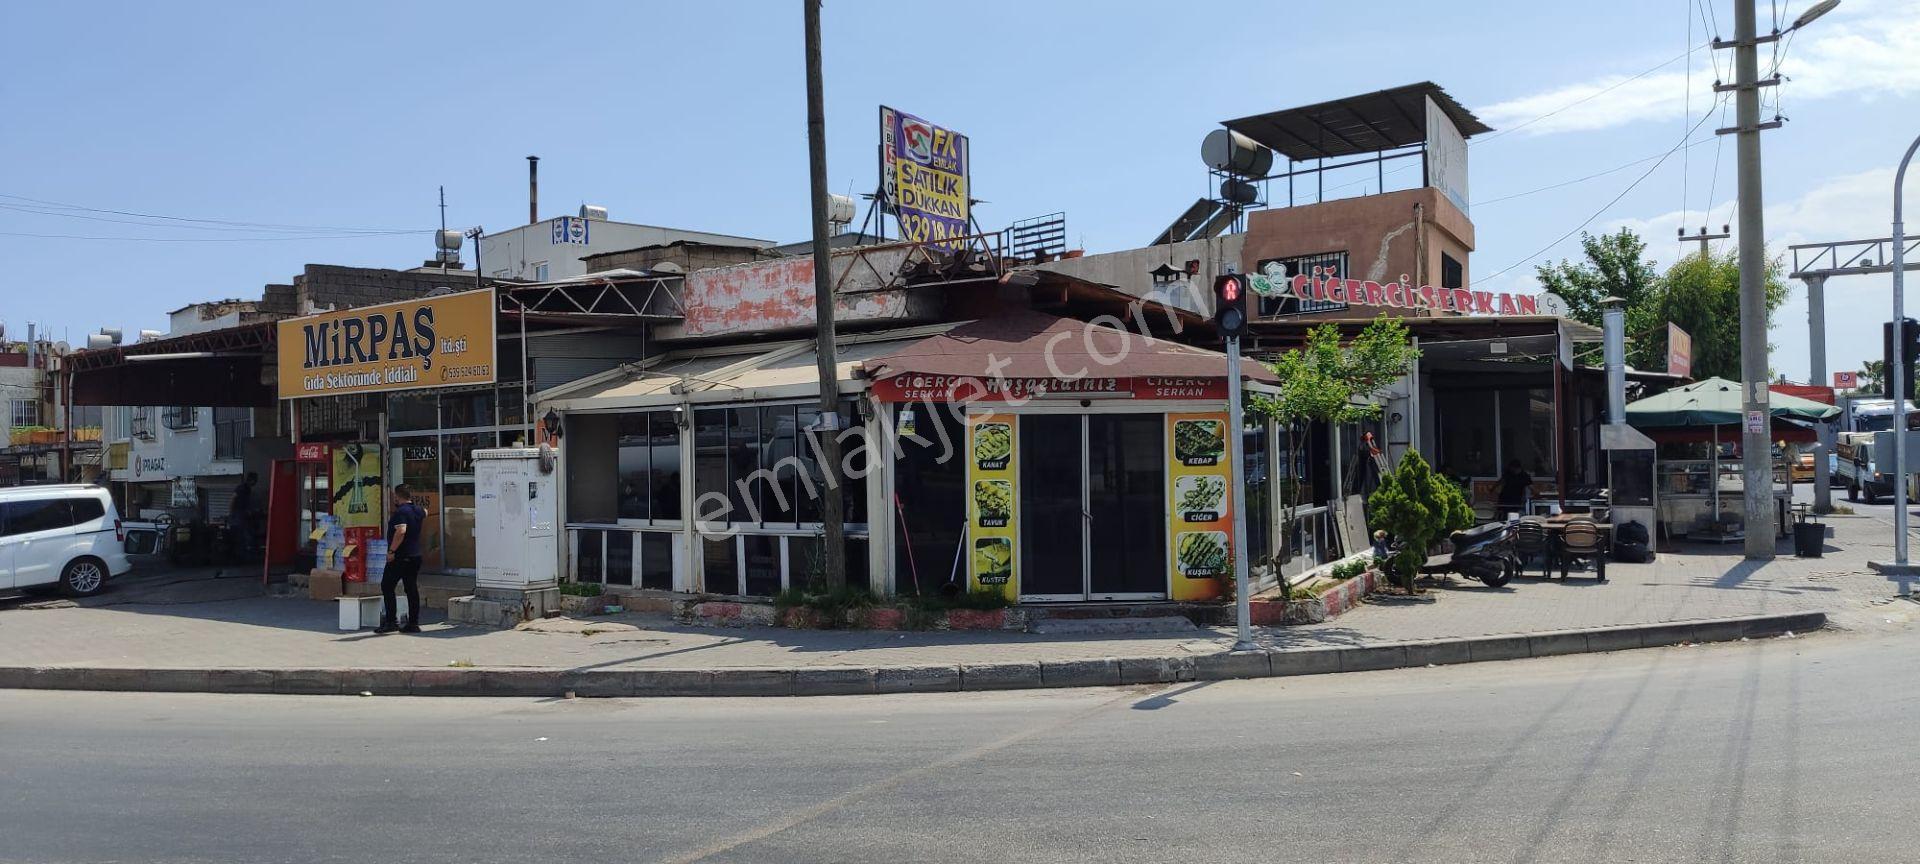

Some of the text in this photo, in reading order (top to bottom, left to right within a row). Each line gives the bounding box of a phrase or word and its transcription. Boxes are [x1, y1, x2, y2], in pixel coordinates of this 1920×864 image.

[933, 129, 956, 160] FA
[902, 163, 959, 198] SATILIK
[903, 188, 961, 218] DÜKKAN
[903, 213, 930, 243] 329
[1419, 285, 1537, 316] SERKAN
[304, 373, 324, 391] Gıda
[326, 367, 382, 390] Sektöründe
[904, 389, 952, 399] SERKAN
[1156, 387, 1203, 397] SERKAN
[982, 460, 1003, 469] KANAT
[1188, 457, 1212, 465] KEBAP
[983, 519, 1003, 527] TAVUK
[1187, 568, 1212, 577] KUŞBA
